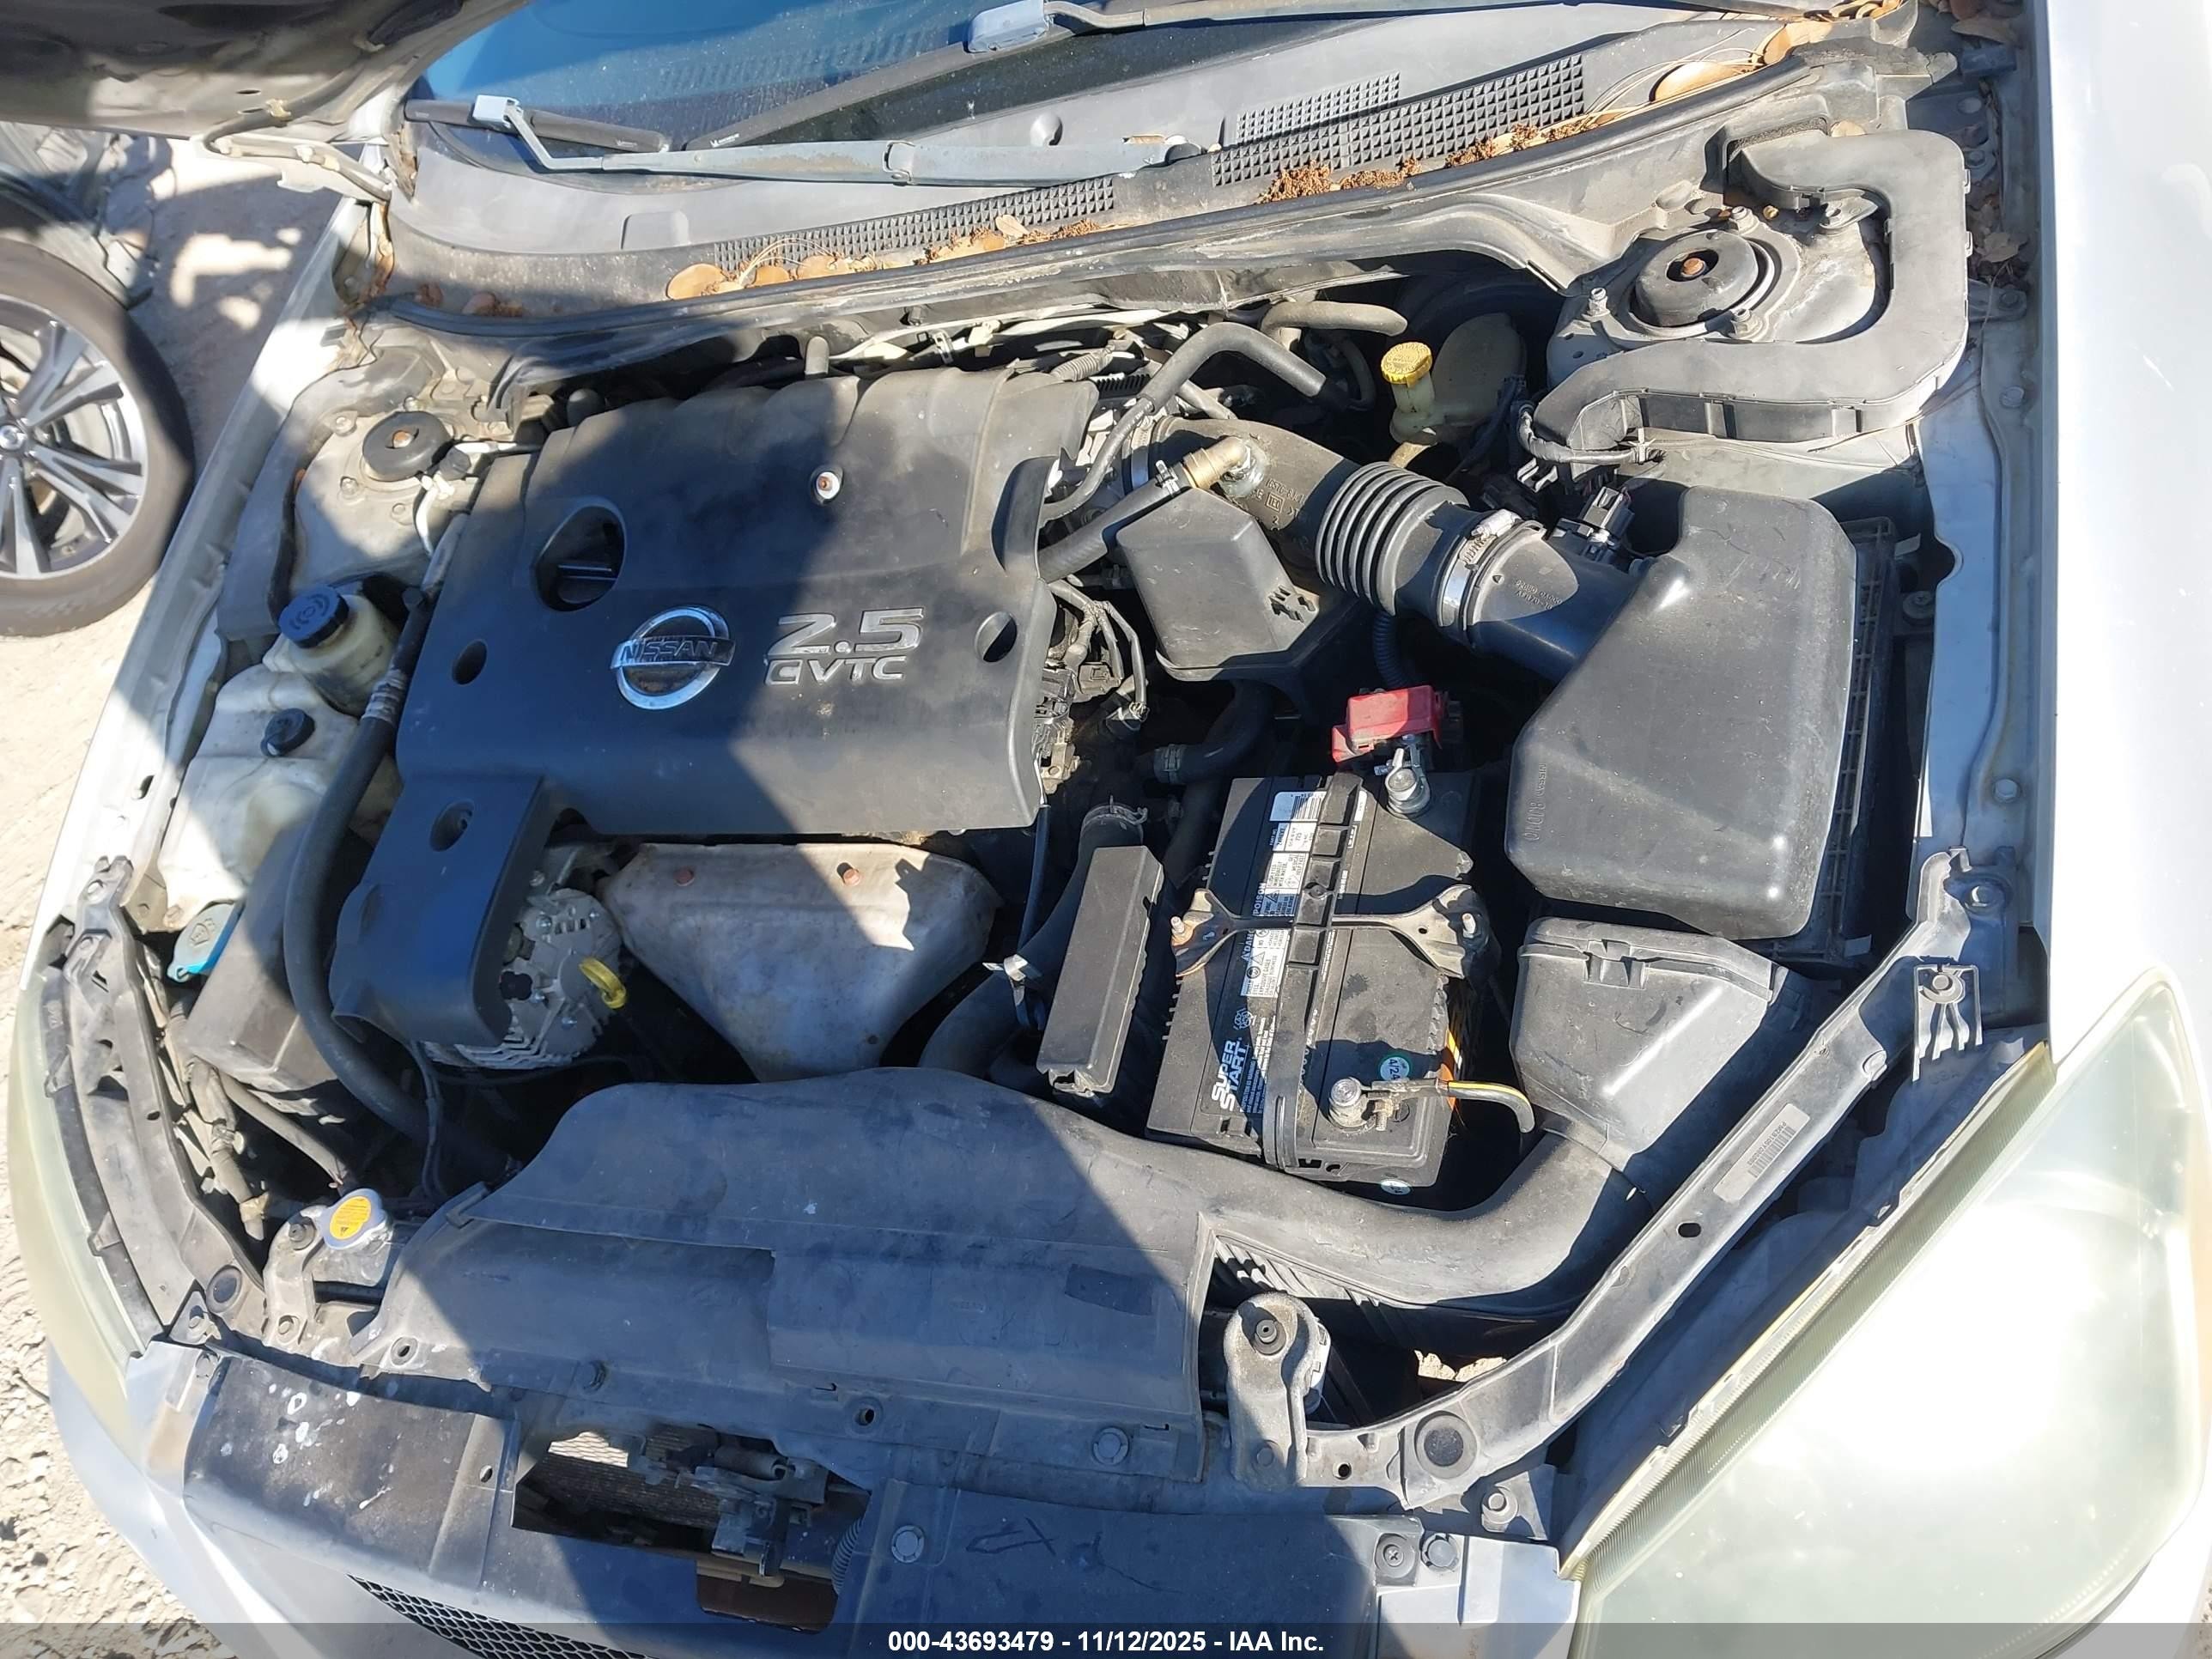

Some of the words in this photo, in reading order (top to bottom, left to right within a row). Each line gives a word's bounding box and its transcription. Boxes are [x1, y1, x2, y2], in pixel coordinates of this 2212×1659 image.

[620, 639, 718, 663] NISSAN
[765, 608, 924, 659] 2.5
[1252, 883, 1267, 915] POISON
[1212, 1040, 1236, 1101] SUPER
[1220, 1039, 1247, 1112] START
